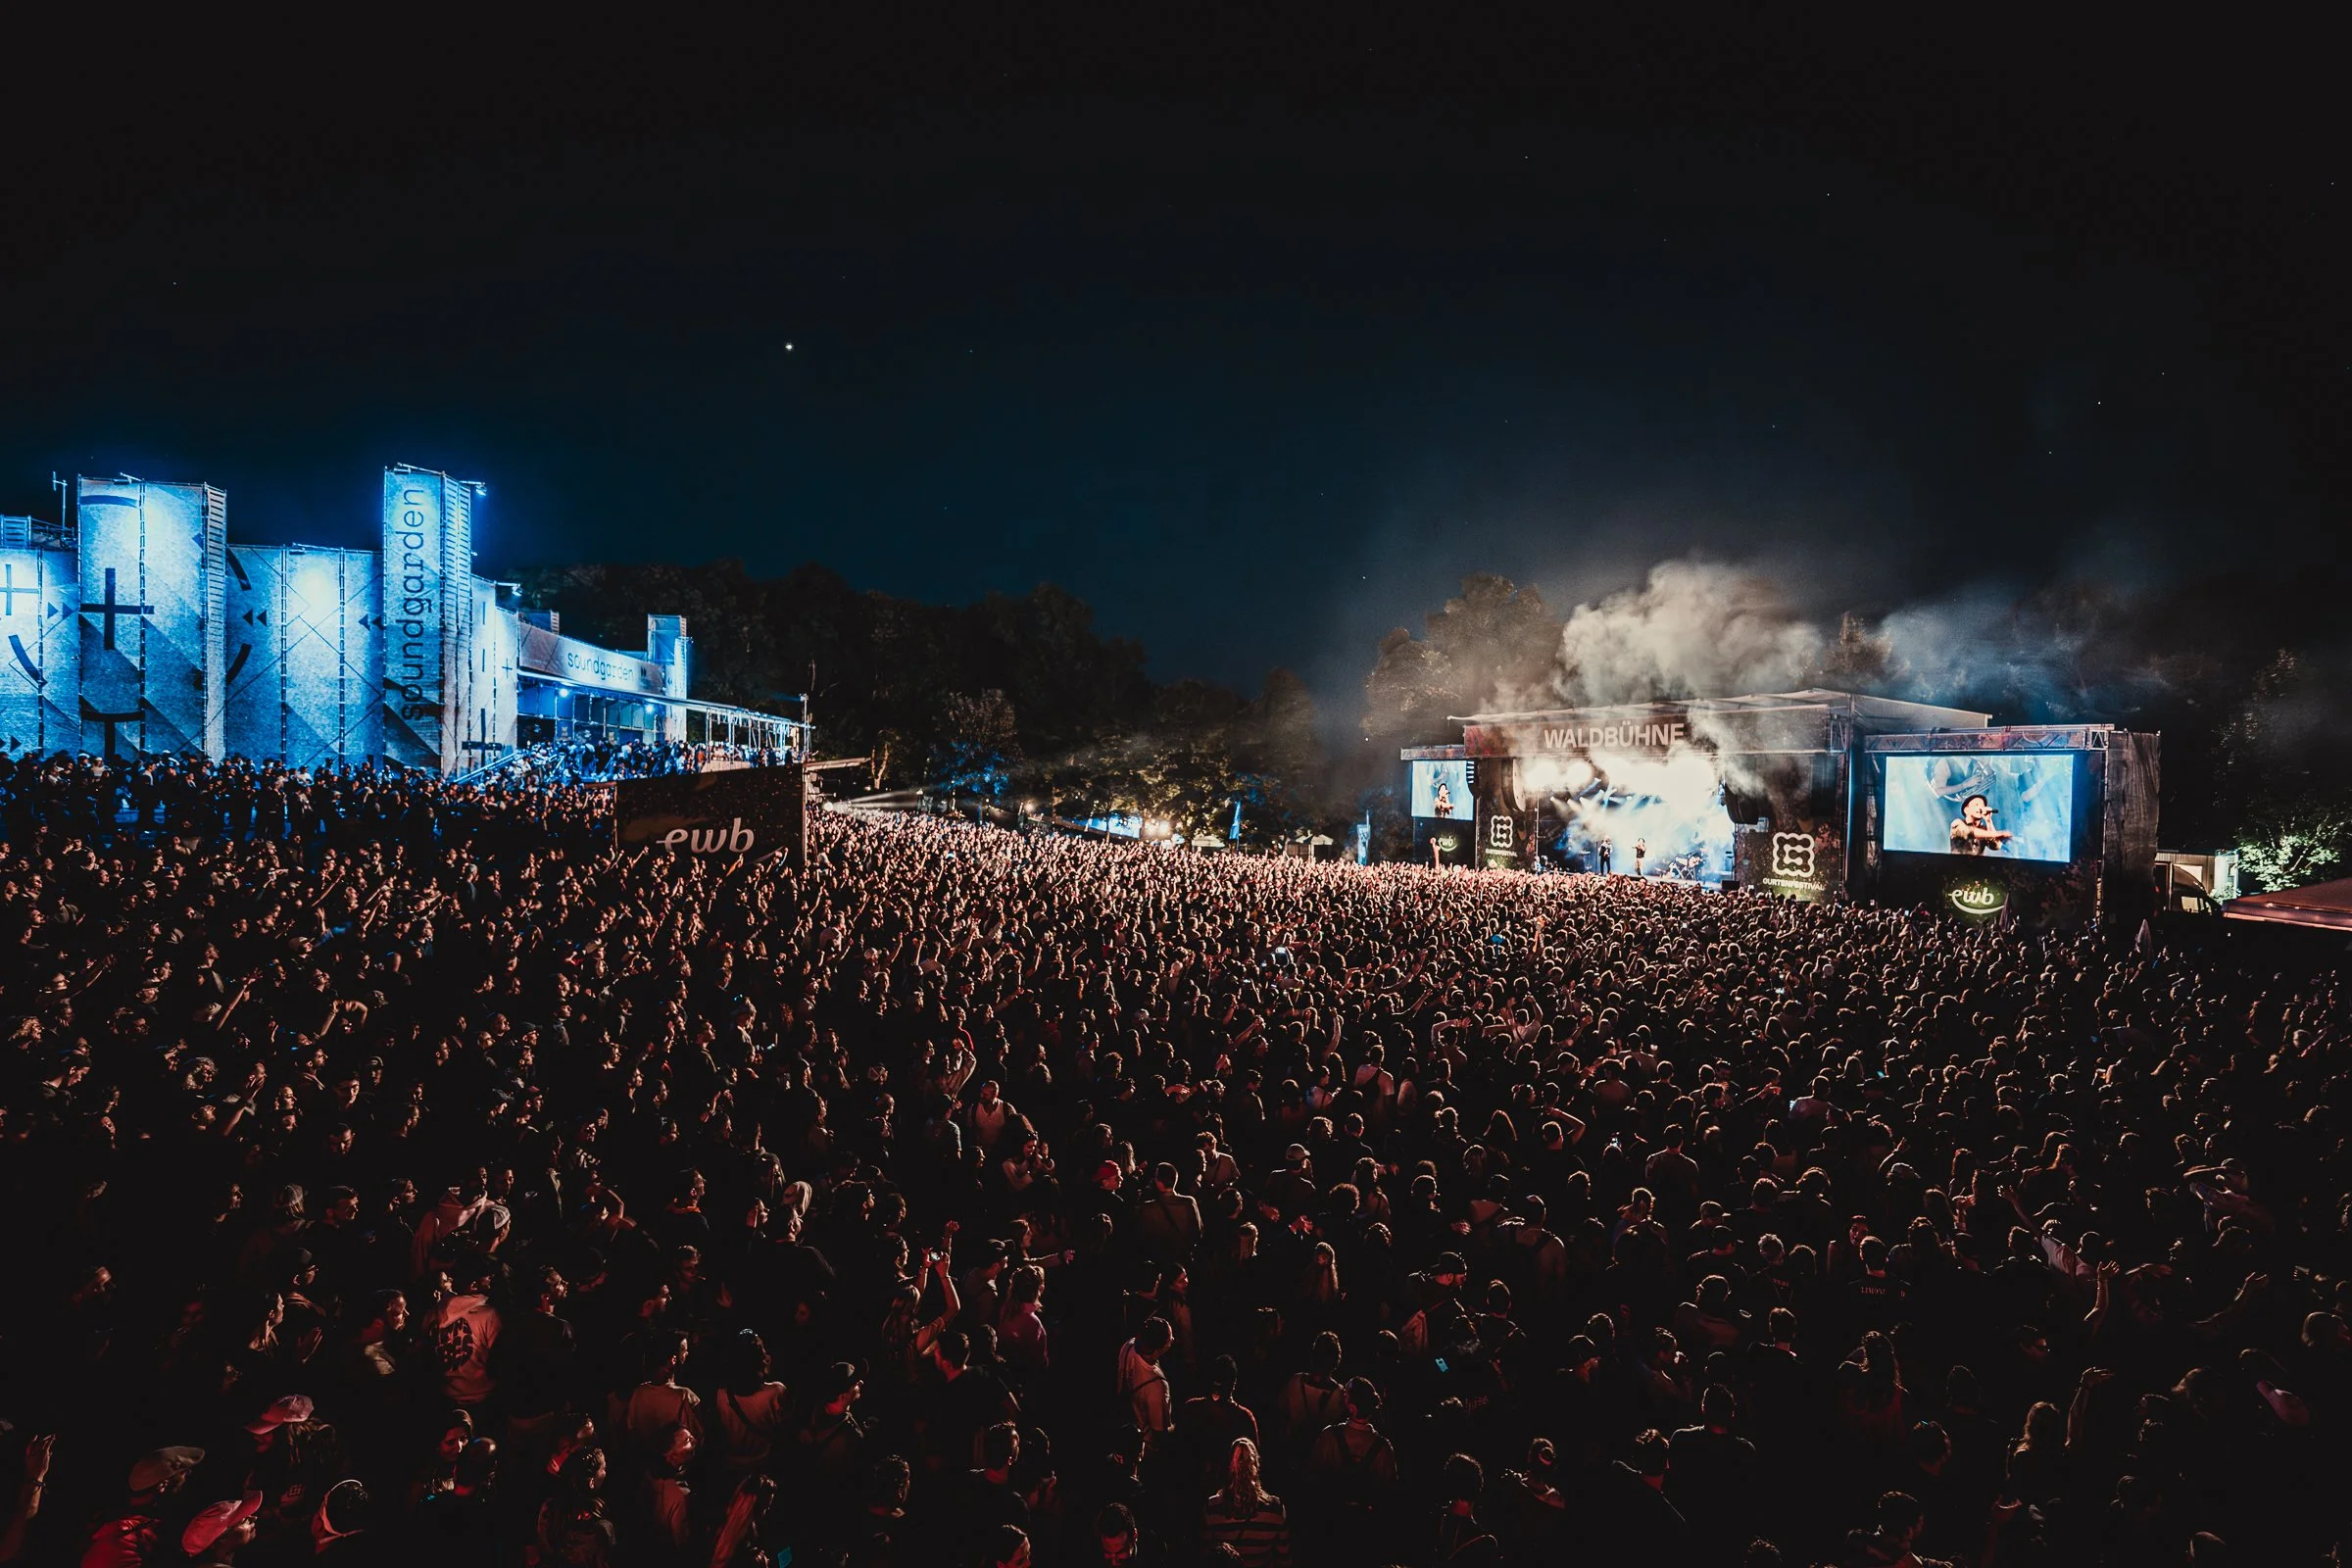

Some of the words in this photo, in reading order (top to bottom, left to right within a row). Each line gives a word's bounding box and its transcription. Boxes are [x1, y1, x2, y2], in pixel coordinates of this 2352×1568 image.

[396, 488, 432, 720] soundgarden
[567, 652, 634, 681] soundgarden
[1544, 720, 1685, 749] WALDBÜHNE
[656, 817, 755, 854] ewb
[1947, 887, 1999, 909] ewb
